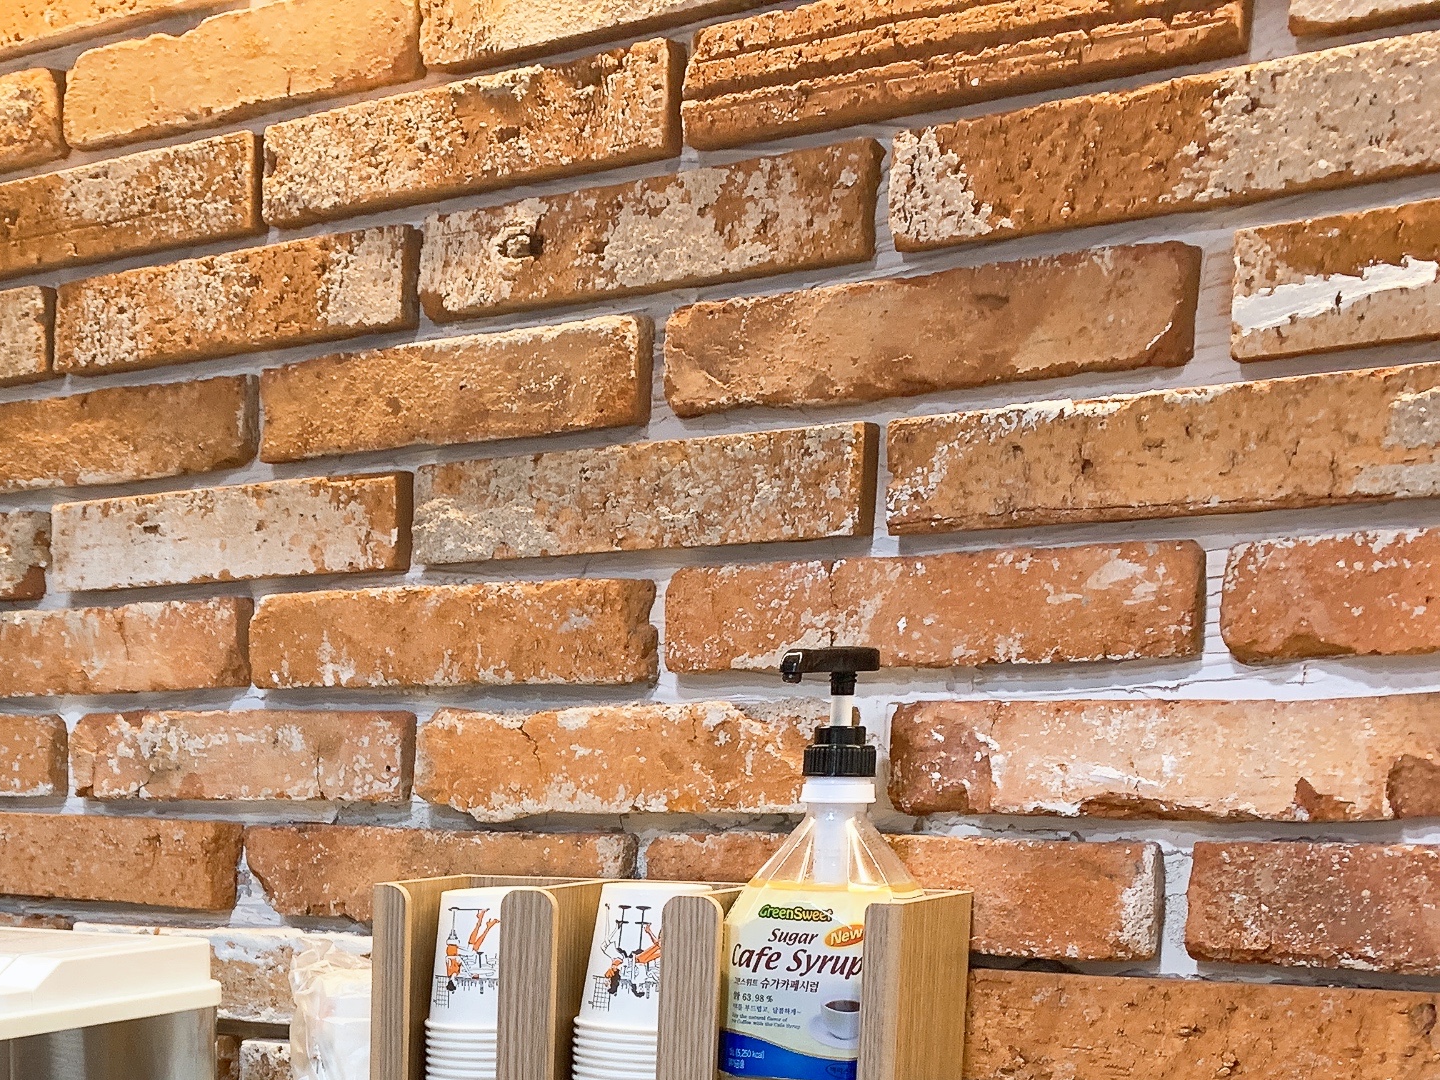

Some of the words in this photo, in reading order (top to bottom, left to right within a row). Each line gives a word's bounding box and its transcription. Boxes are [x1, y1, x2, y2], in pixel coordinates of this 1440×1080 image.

[758, 904, 833, 922] GreenSweet
[768, 927, 819, 946] Sugar
[830, 927, 863, 946] New
[732, 944, 781, 973] Cafe
[786, 949, 863, 980] Syrup
[760, 977, 819, 993] 슈가카페시럽
[742, 993, 765, 1003] 63.98
